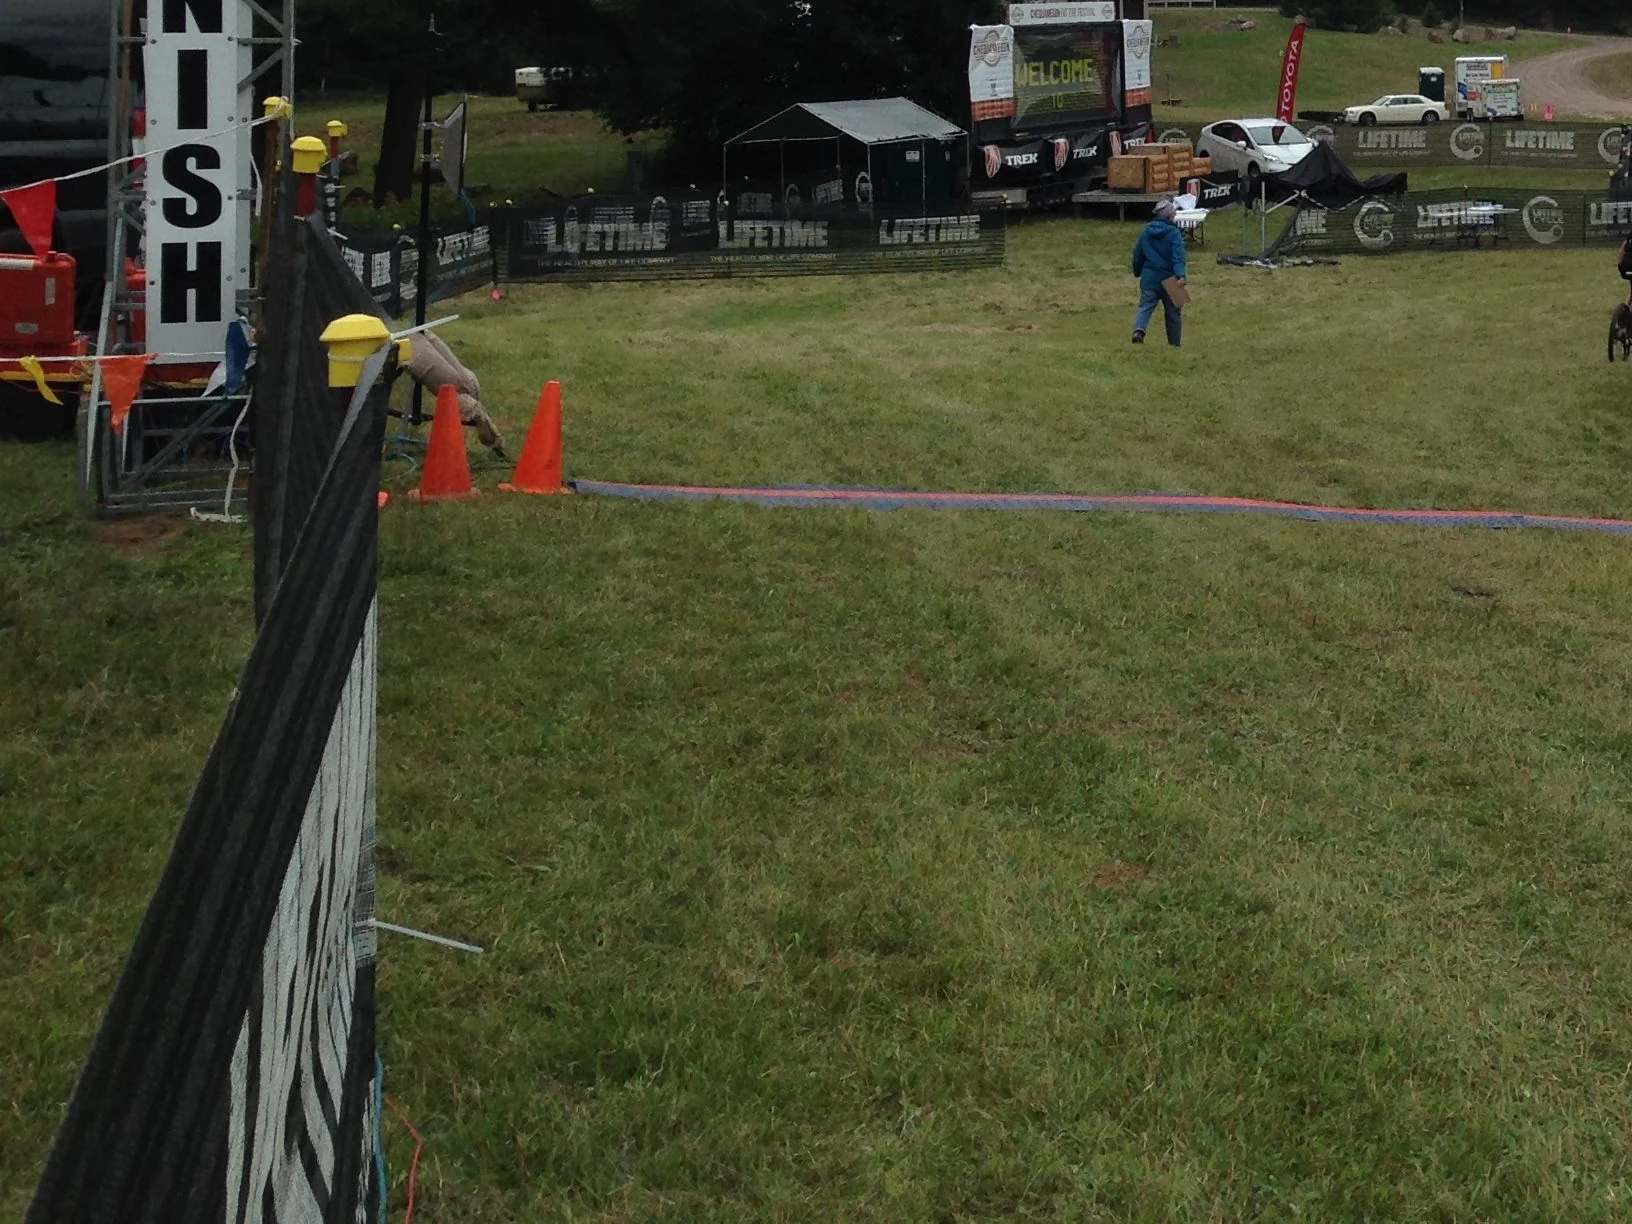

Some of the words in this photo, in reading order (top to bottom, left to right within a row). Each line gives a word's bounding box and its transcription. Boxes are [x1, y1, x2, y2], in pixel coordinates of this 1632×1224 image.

[1015, 58, 1096, 87] WELCOME
[1281, 40, 1300, 113] TOYOTA
[1358, 130, 1427, 148] LIFETIME
[1505, 130, 1575, 150] LIFETIME
[1005, 152, 1038, 167] TREK
[1073, 145, 1098, 159] TREK
[1203, 186, 1231, 199] TREK
[718, 220, 829, 249] LIFETIME
[880, 215, 980, 245] LIFETIME
